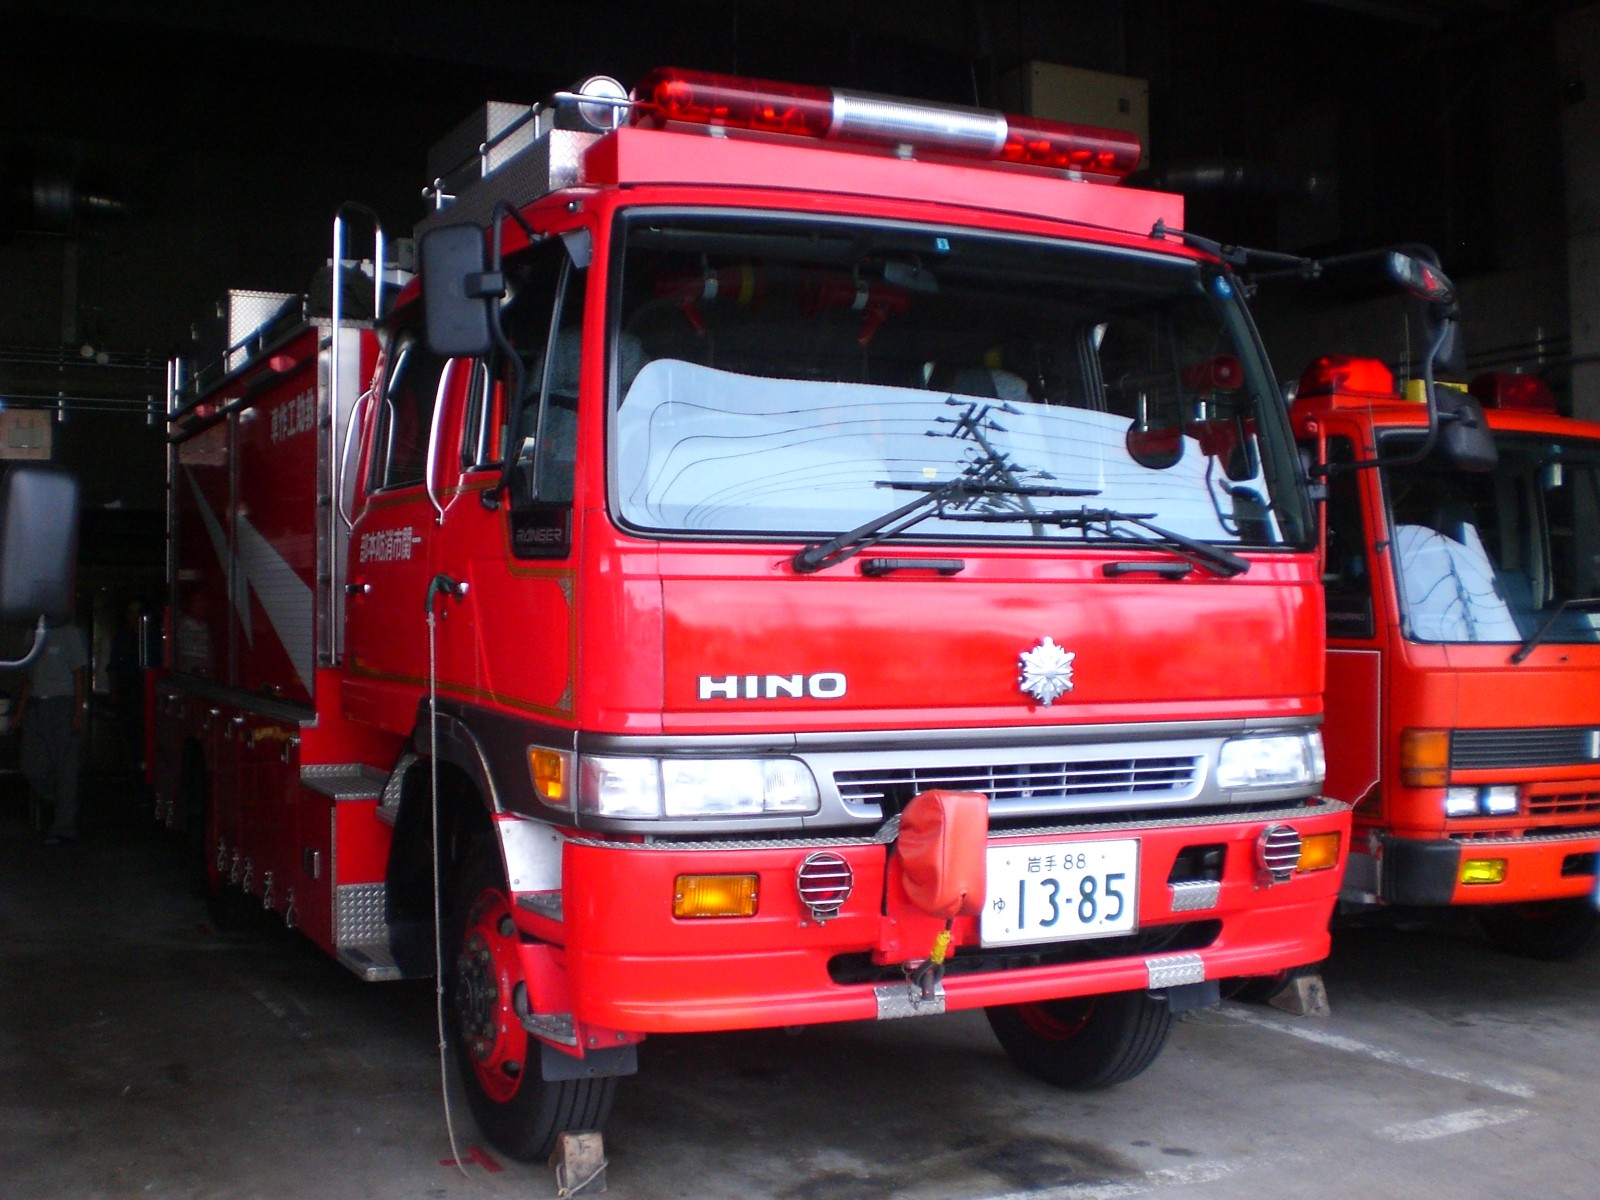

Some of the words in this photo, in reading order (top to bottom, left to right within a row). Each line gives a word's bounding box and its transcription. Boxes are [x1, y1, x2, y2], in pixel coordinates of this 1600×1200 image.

[699, 672, 847, 699] HINO
[1027, 855, 1057, 873] 岩手
[1063, 853, 1086, 870] 88
[992, 897, 1006, 914] ゆ
[1018, 872, 1126, 930] 13-85
